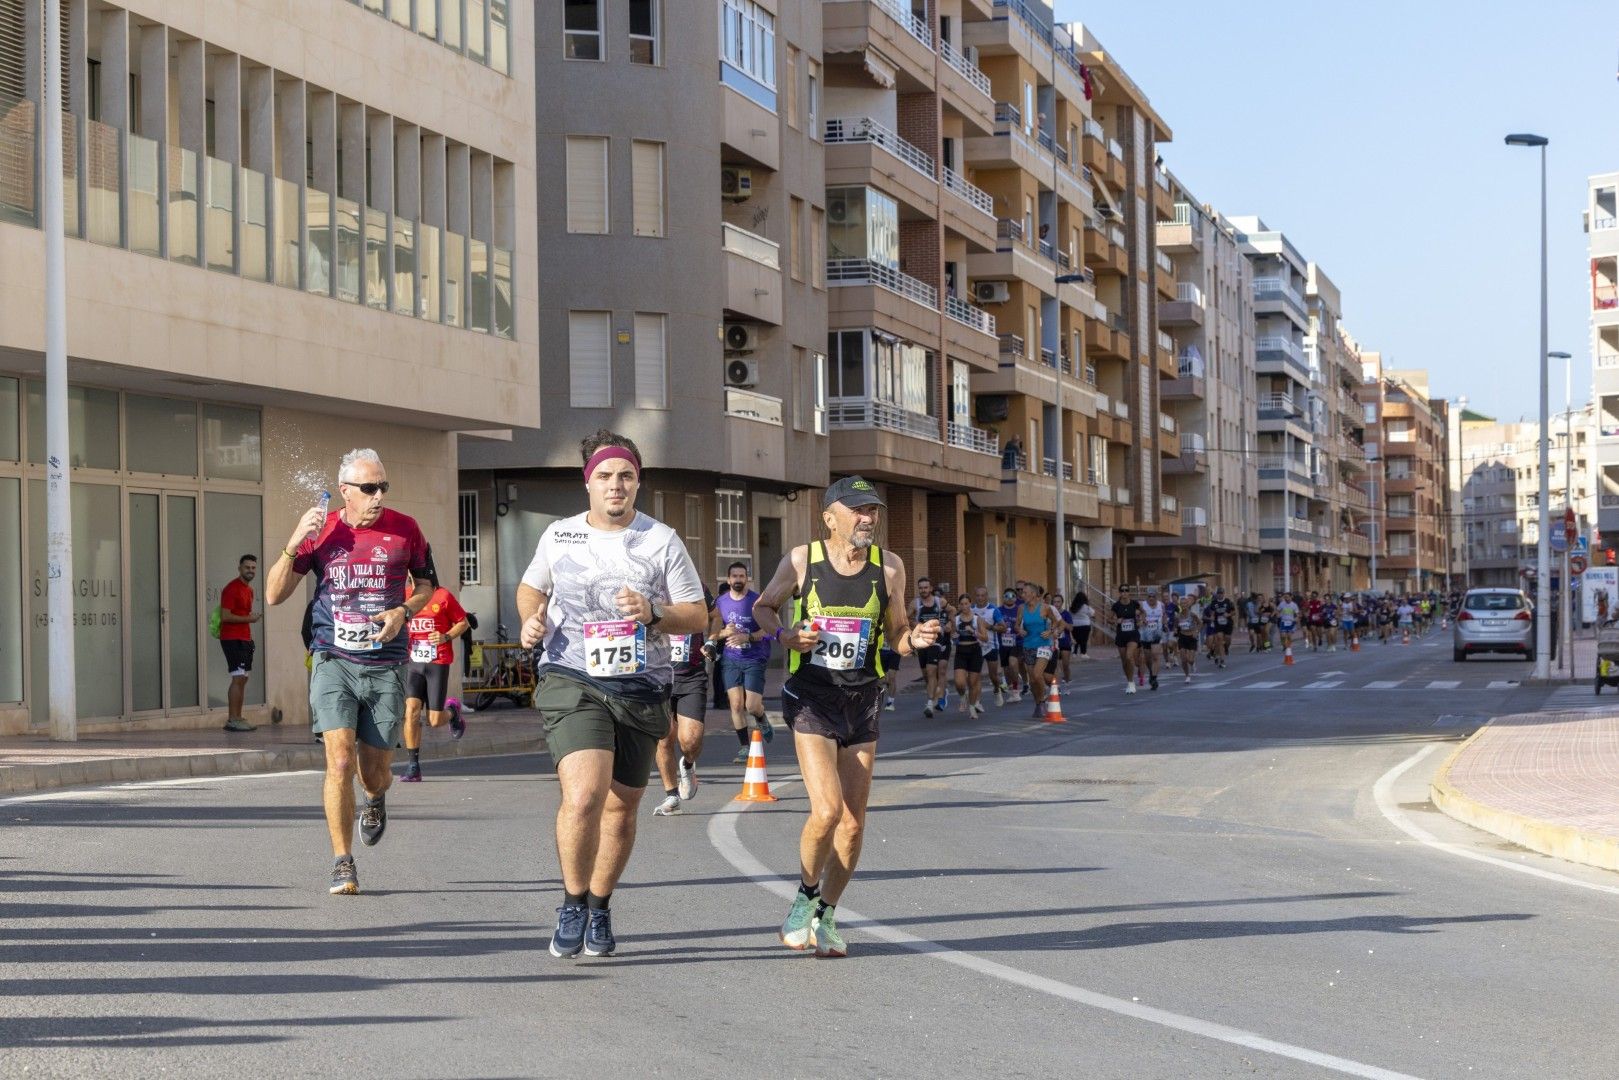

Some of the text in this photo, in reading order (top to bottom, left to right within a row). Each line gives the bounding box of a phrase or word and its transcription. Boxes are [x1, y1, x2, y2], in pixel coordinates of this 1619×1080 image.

[554, 531, 589, 540] KARATE
[329, 566, 346, 578] 10K
[352, 564, 386, 576] VILLA DE
[334, 578, 346, 590] 5K
[81, 613, 97, 626] 961
[101, 613, 117, 626] 016
[410, 618, 433, 631] AIG
[337, 627, 369, 643] 222
[636, 639, 645, 656] KM
[814, 640, 855, 659] 206
[859, 638, 868, 653] KM
[414, 650, 430, 658] 132
[590, 645, 632, 665] 175
